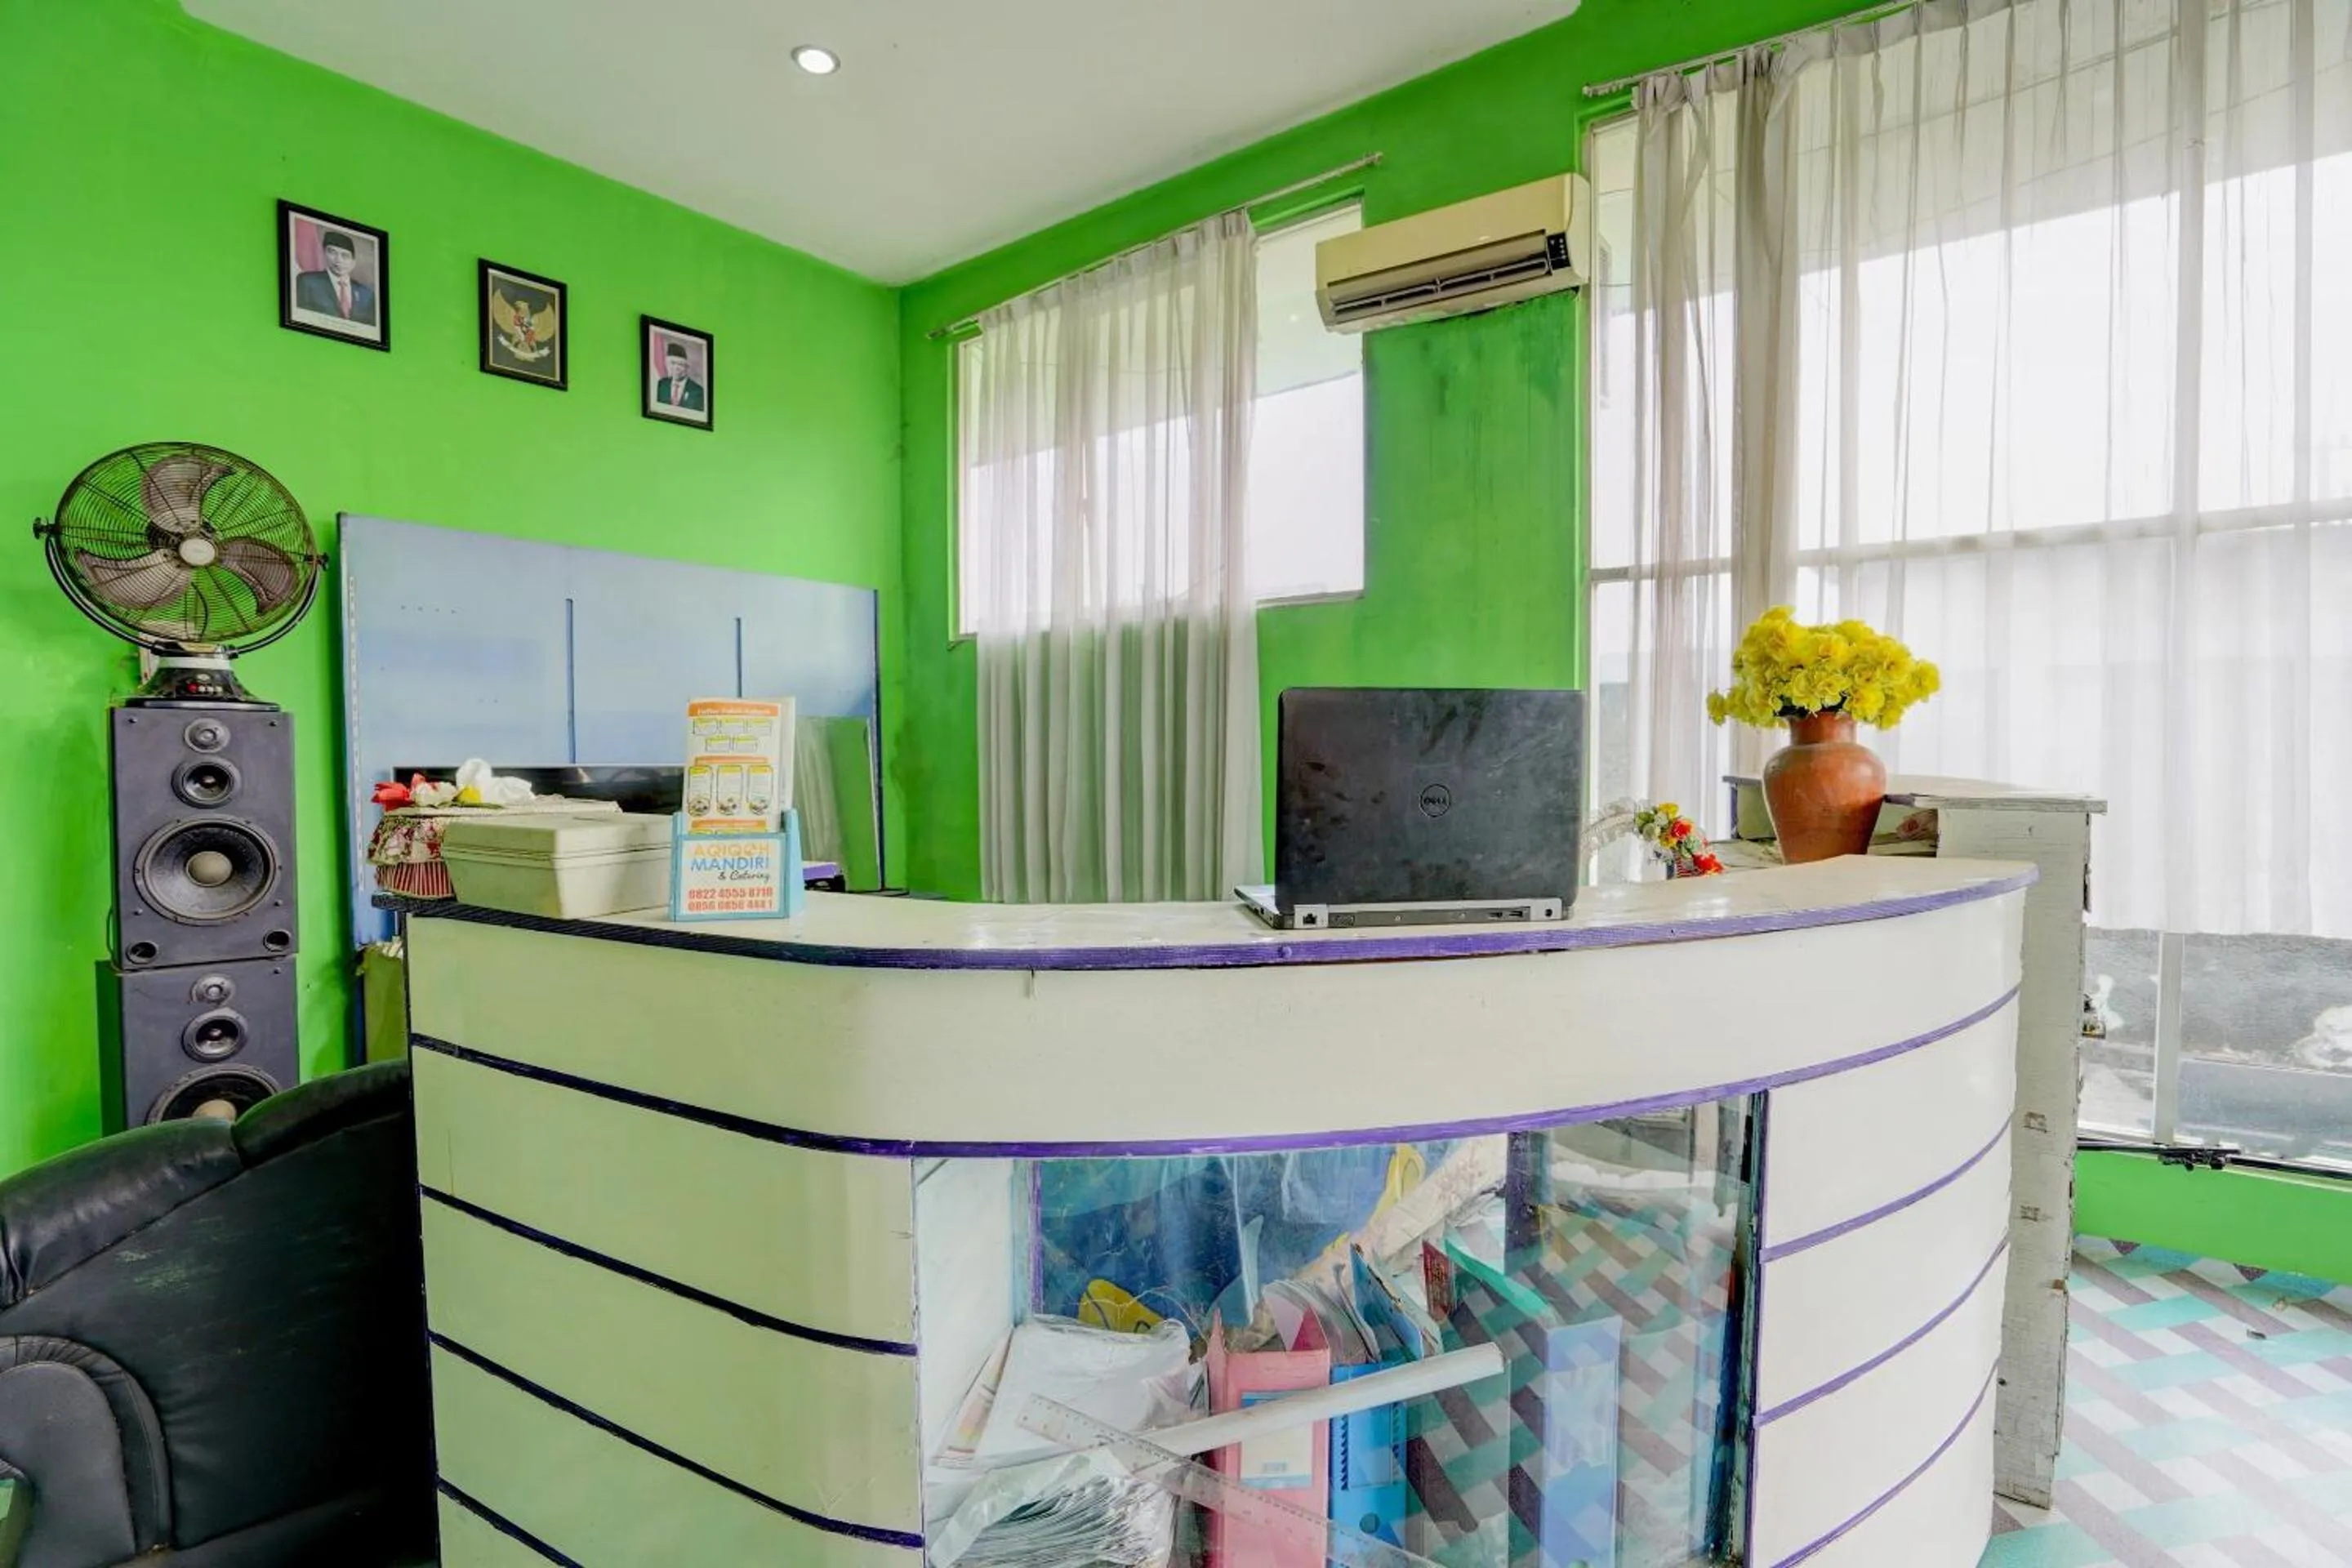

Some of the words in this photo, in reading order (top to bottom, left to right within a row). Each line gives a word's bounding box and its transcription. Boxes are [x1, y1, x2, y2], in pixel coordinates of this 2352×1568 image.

[1423, 797, 1446, 805] DELL
[691, 857, 768, 871] MANDIRI
[718, 871, 727, 880] &
[729, 870, 770, 884] Catering
[688, 888, 716, 899] 0822
